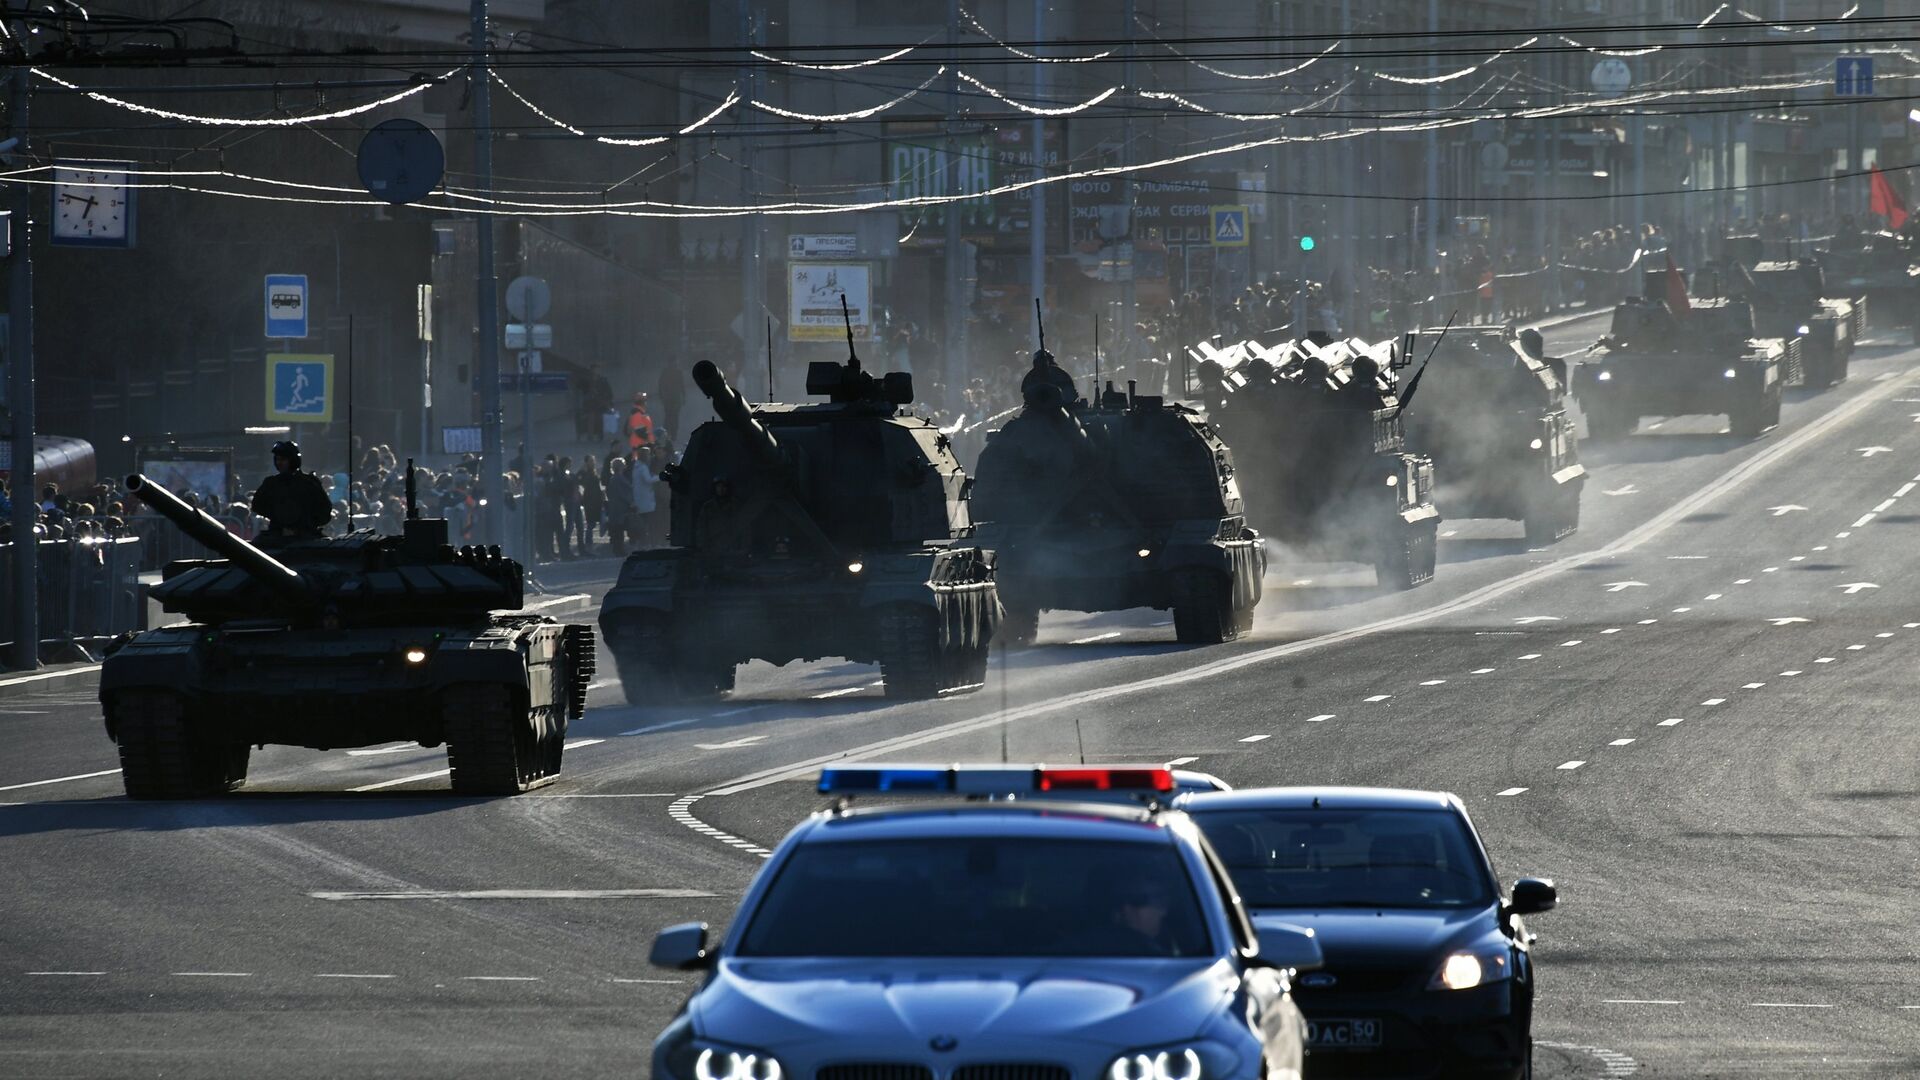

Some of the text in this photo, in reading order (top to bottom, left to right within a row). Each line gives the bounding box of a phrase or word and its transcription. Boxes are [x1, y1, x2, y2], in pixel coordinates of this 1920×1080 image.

[999, 151, 1015, 165] 29
[87, 176, 96, 184] 12
[1071, 181, 1111, 194] ФОТО
[1142, 180, 1210, 193] ЛОМБАРД
[1169, 204, 1210, 217] СЕРВИ
[1323, 1025, 1349, 1043] AC
[1353, 1019, 1375, 1038] 50
